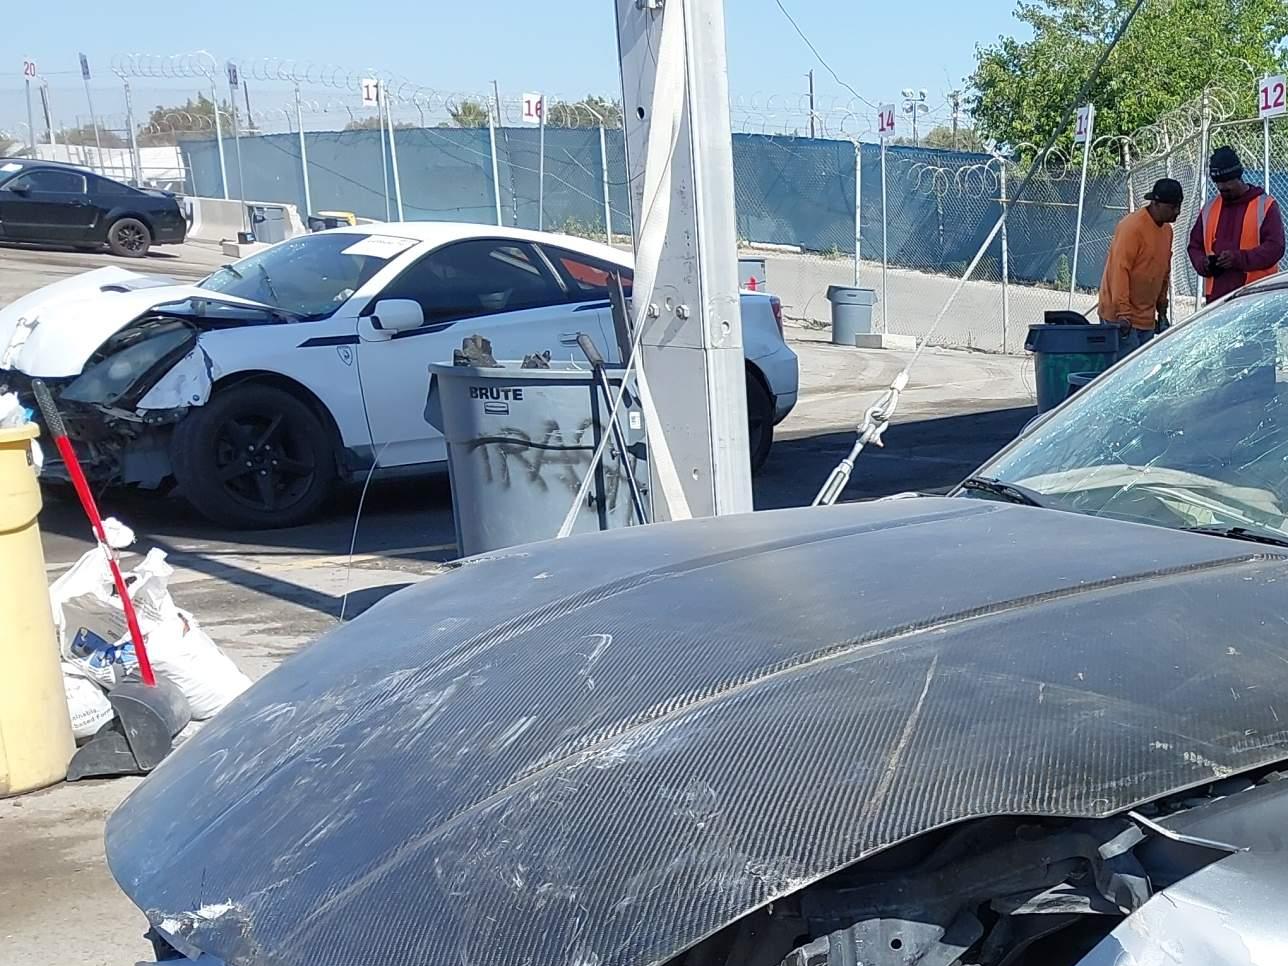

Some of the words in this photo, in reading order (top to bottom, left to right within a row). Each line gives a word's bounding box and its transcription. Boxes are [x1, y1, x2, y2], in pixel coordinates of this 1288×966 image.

[24, 61, 36, 77] 20
[1261, 83, 1284, 110] 12
[879, 110, 895, 132] 14
[469, 386, 523, 400] BRUTE
